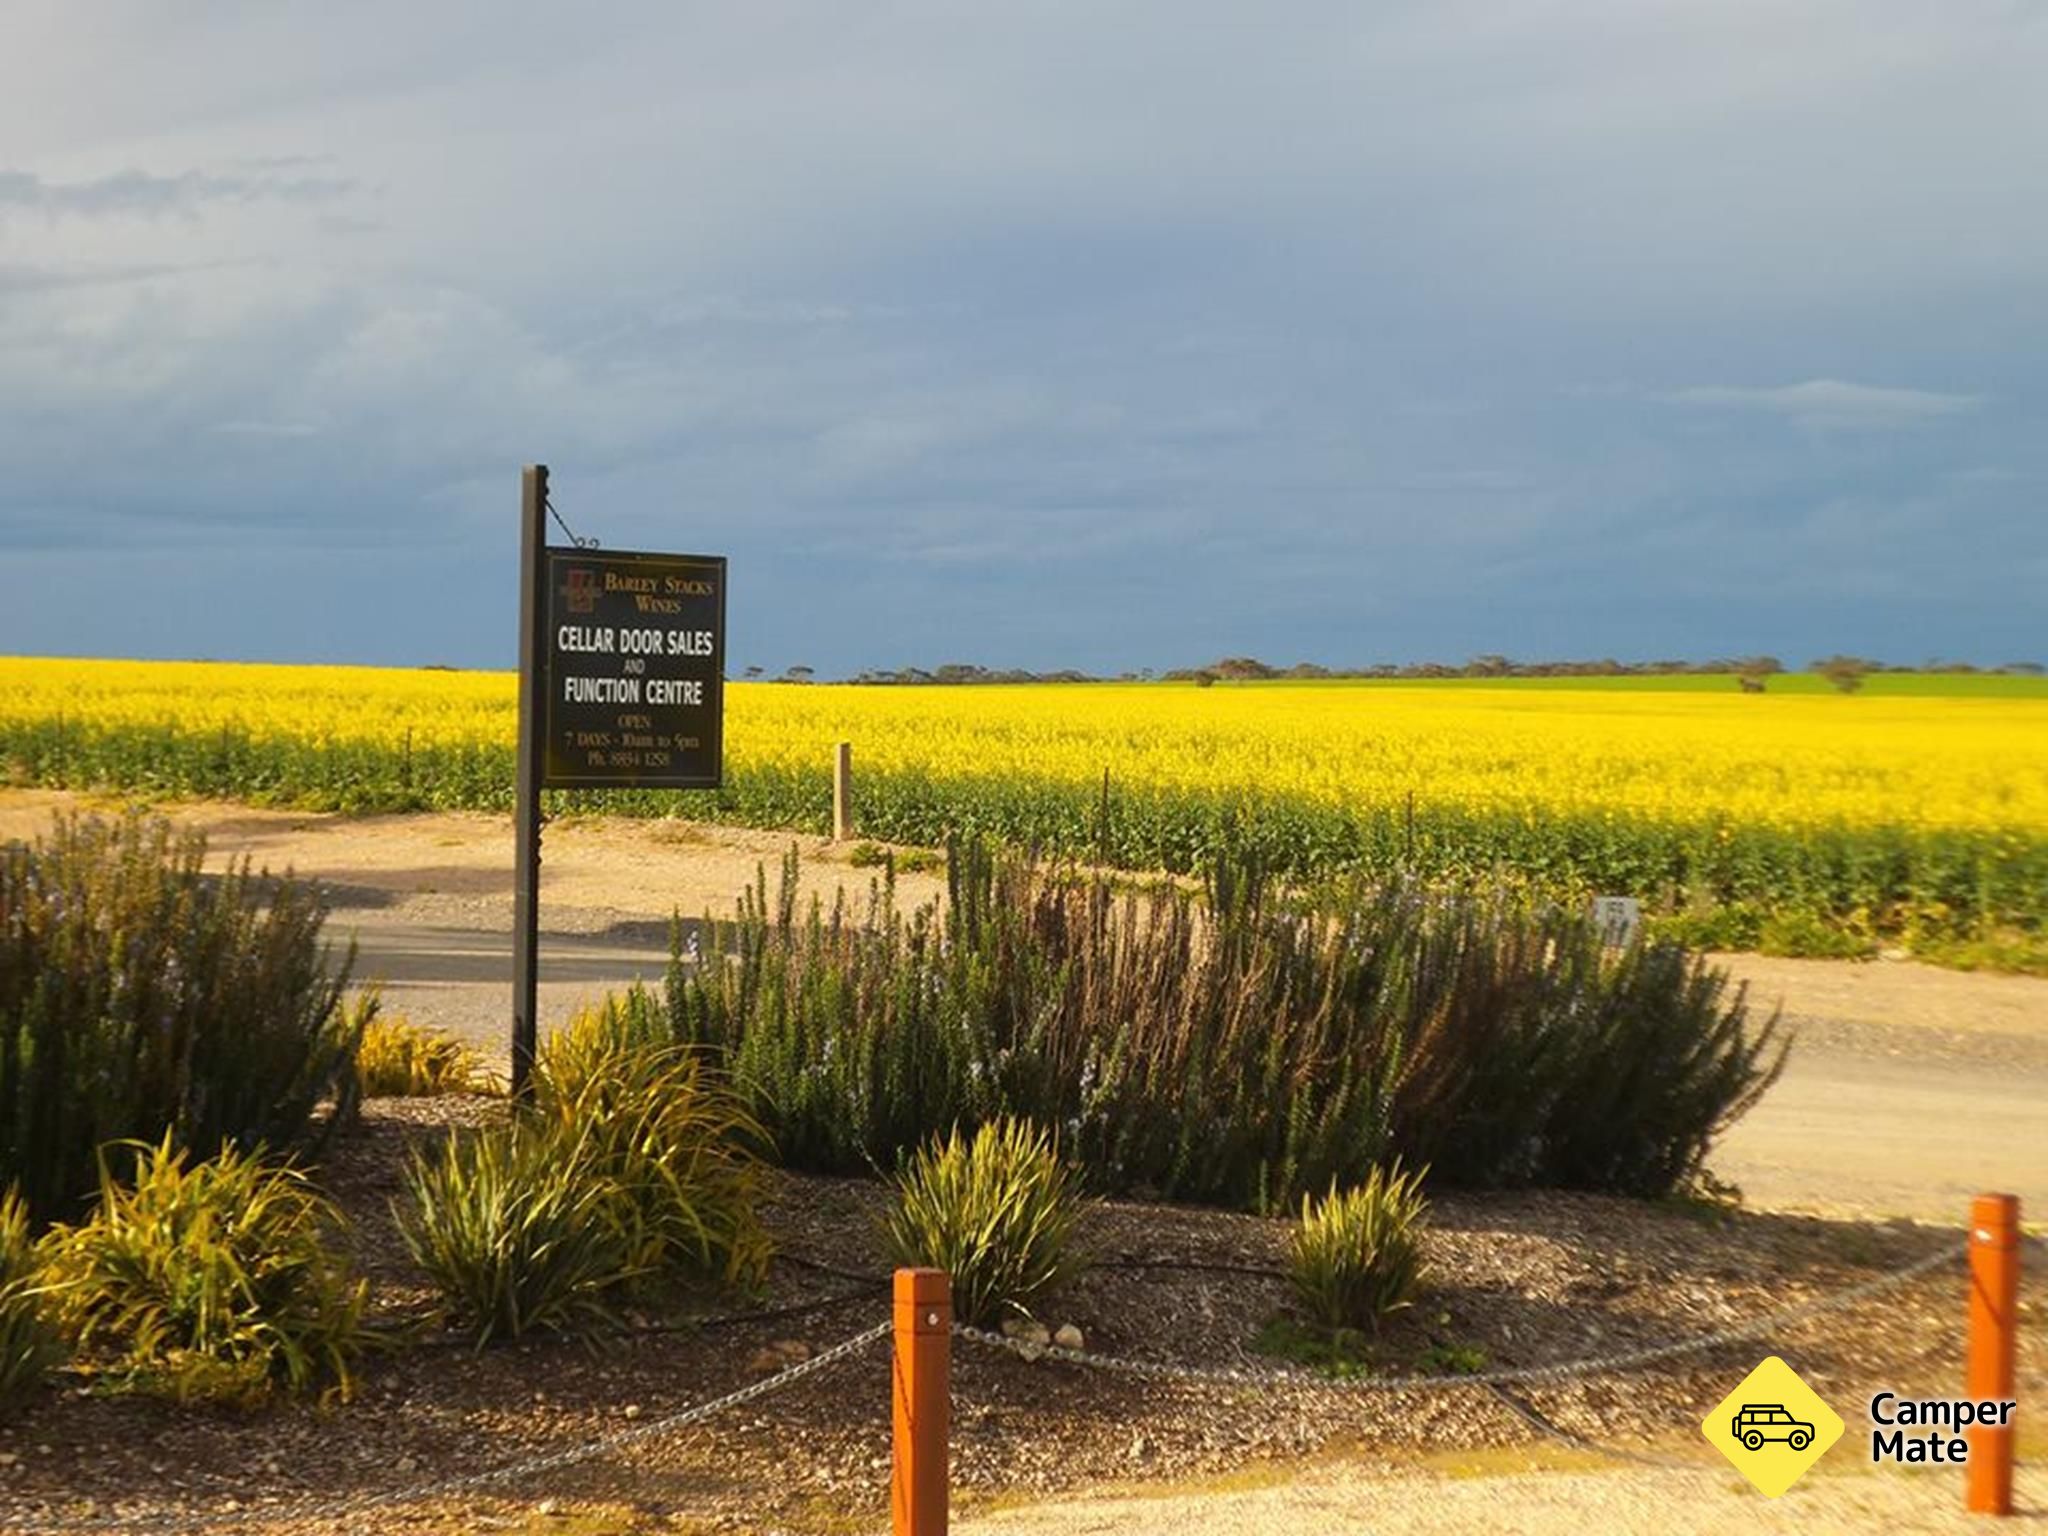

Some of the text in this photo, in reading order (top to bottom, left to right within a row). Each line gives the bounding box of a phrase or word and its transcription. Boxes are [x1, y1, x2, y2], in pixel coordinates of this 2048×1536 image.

[636, 594, 682, 614] WINES
[558, 626, 713, 656] CELLAR DOOR SALES
[623, 659, 645, 674] AND
[565, 678, 702, 705] FUNCTION CENTRE
[617, 714, 652, 728] OPEN
